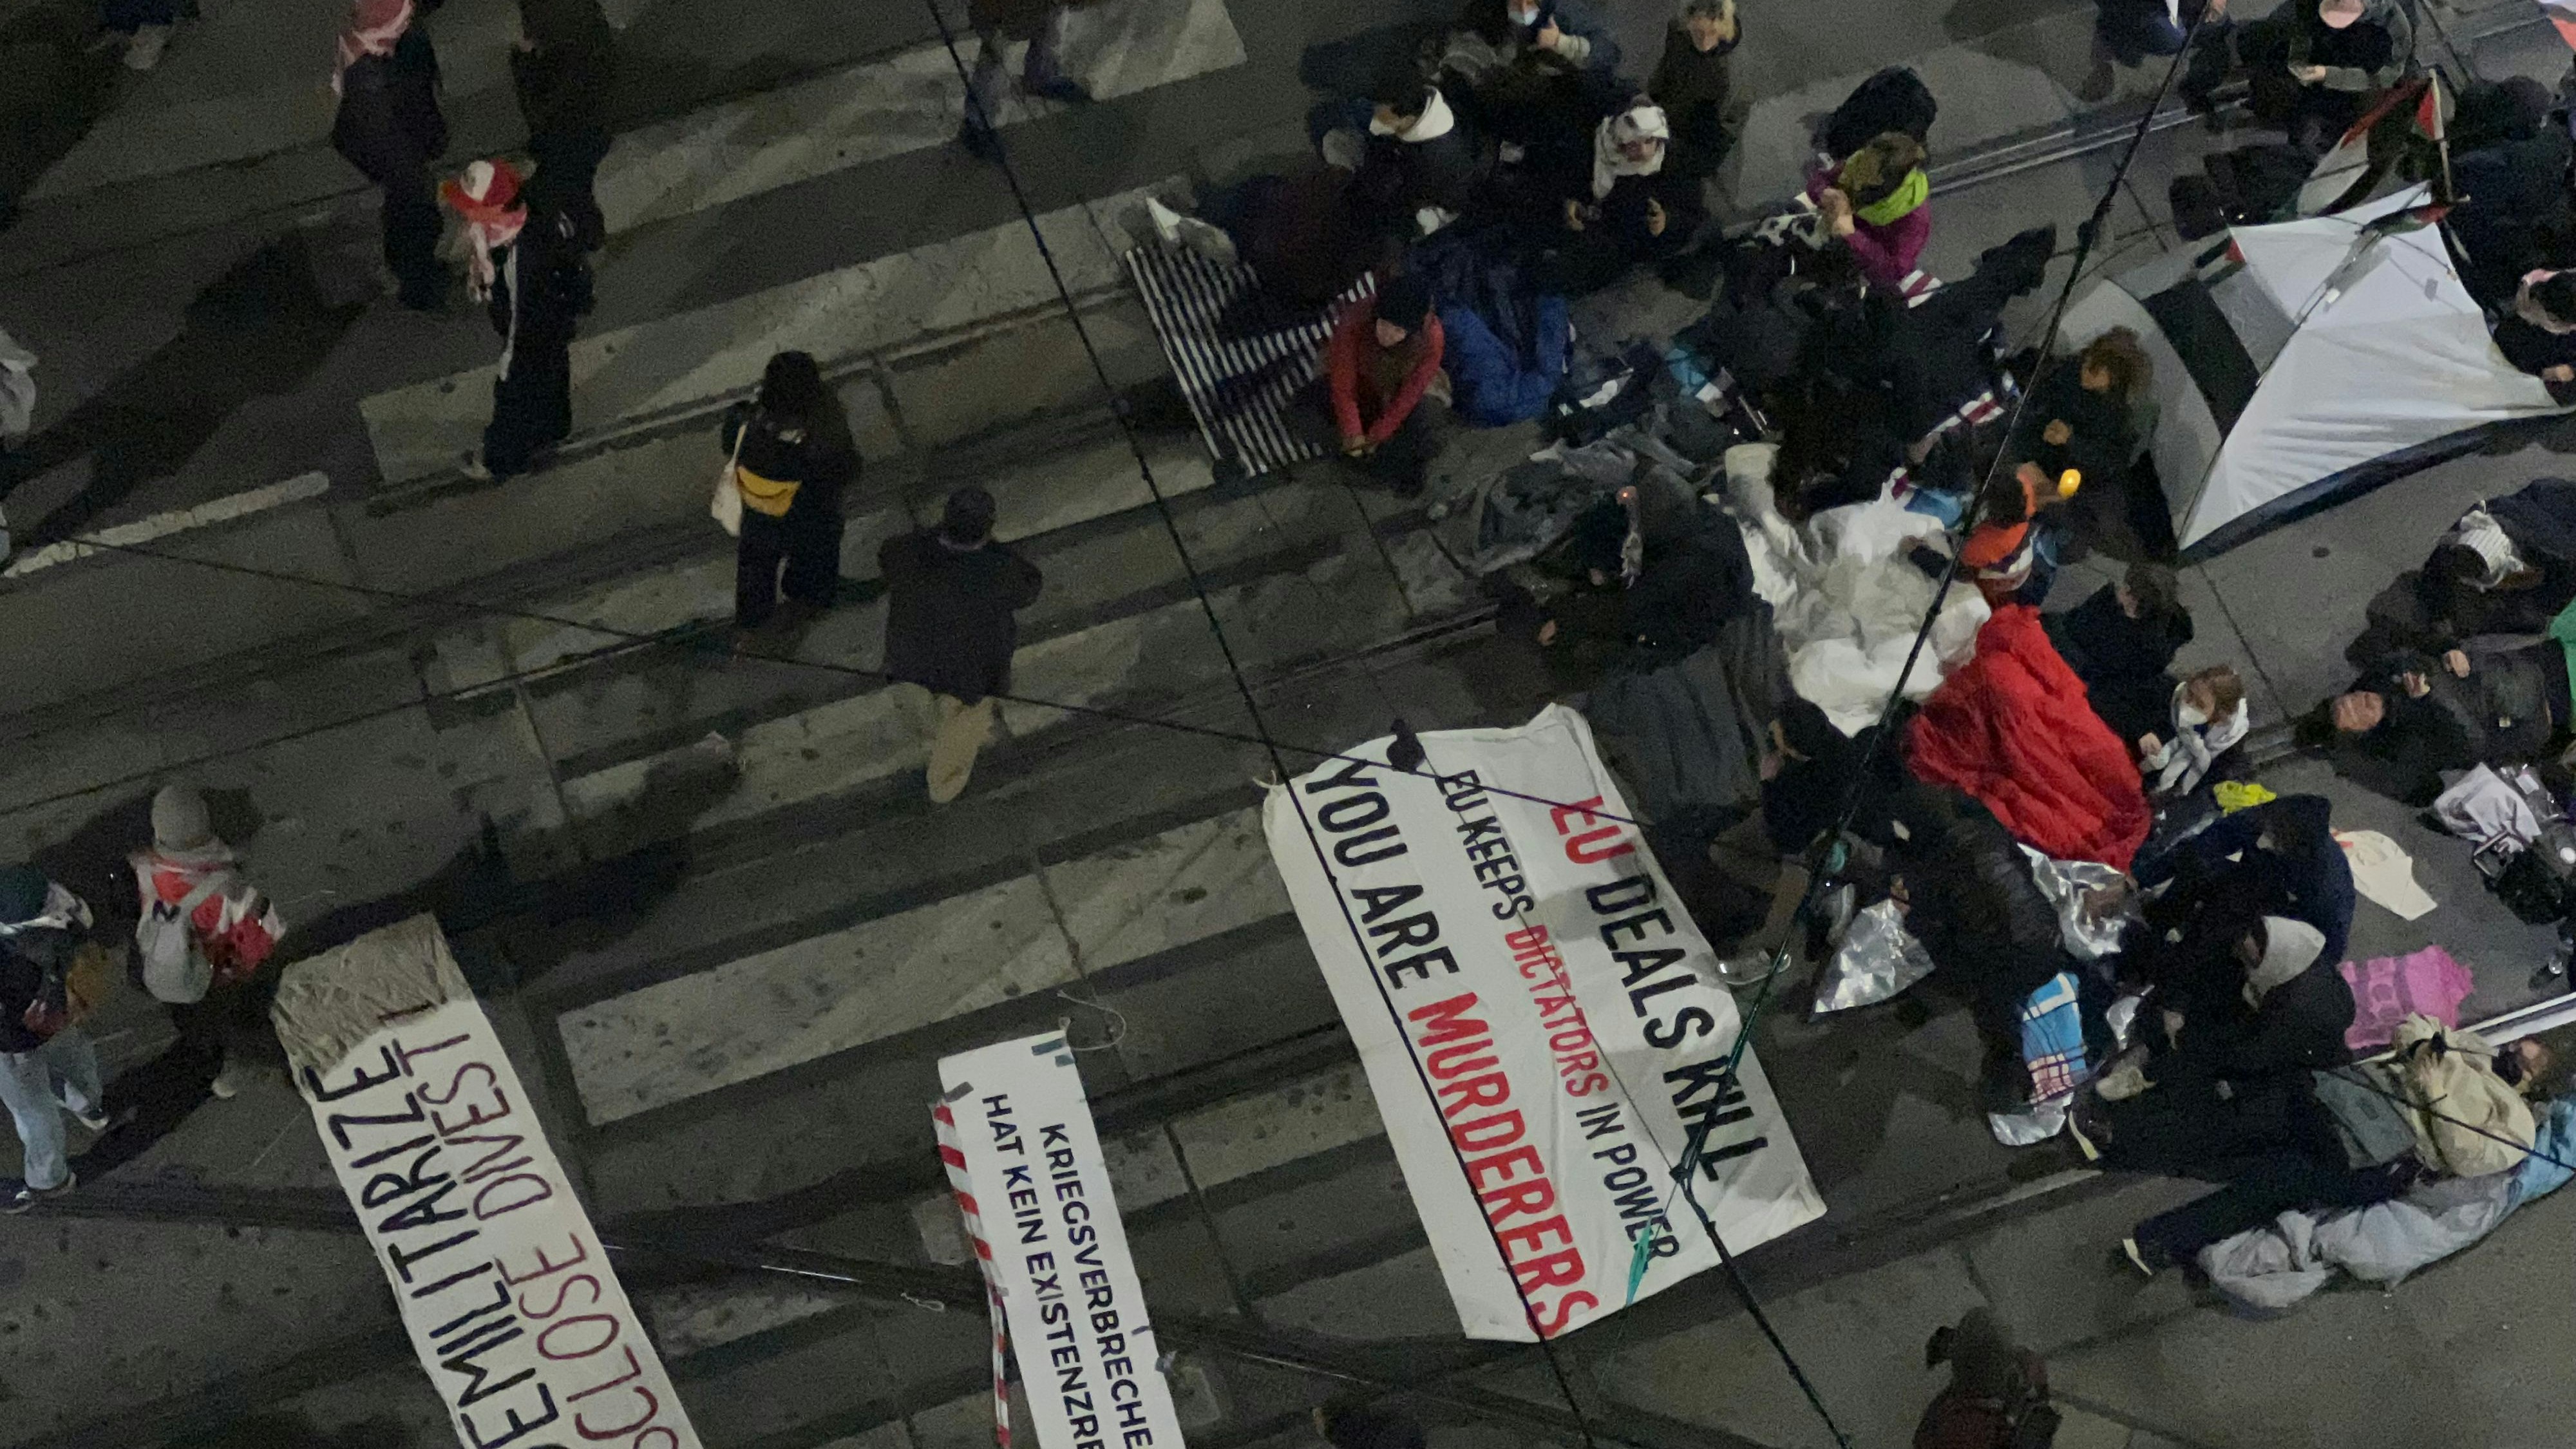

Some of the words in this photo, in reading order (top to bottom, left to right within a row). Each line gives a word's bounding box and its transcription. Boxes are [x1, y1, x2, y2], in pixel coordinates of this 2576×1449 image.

[1305, 759, 1408, 867] YOU
[1435, 770, 1484, 813] EU
[1550, 795, 1636, 864] EU
[1457, 813, 1535, 922] KEEPS
[1351, 885, 1460, 990] ARE
[1587, 876, 1714, 1050] DEALS
[1506, 925, 1610, 1098] DICTATORS
[981, 1094, 1025, 1155] HAT
[1003, 1165, 1047, 1244] KEIN
[1408, 992, 1599, 1338] MURDERERS
[1577, 1103, 1625, 1141] IN
[1664, 1055, 1768, 1182] KILL
[302, 1044, 567, 1449] EMILITARIZE
[1592, 1143, 1680, 1262] POWER
[1039, 1123, 1153, 1449] KRIEGSVERBRECHE
